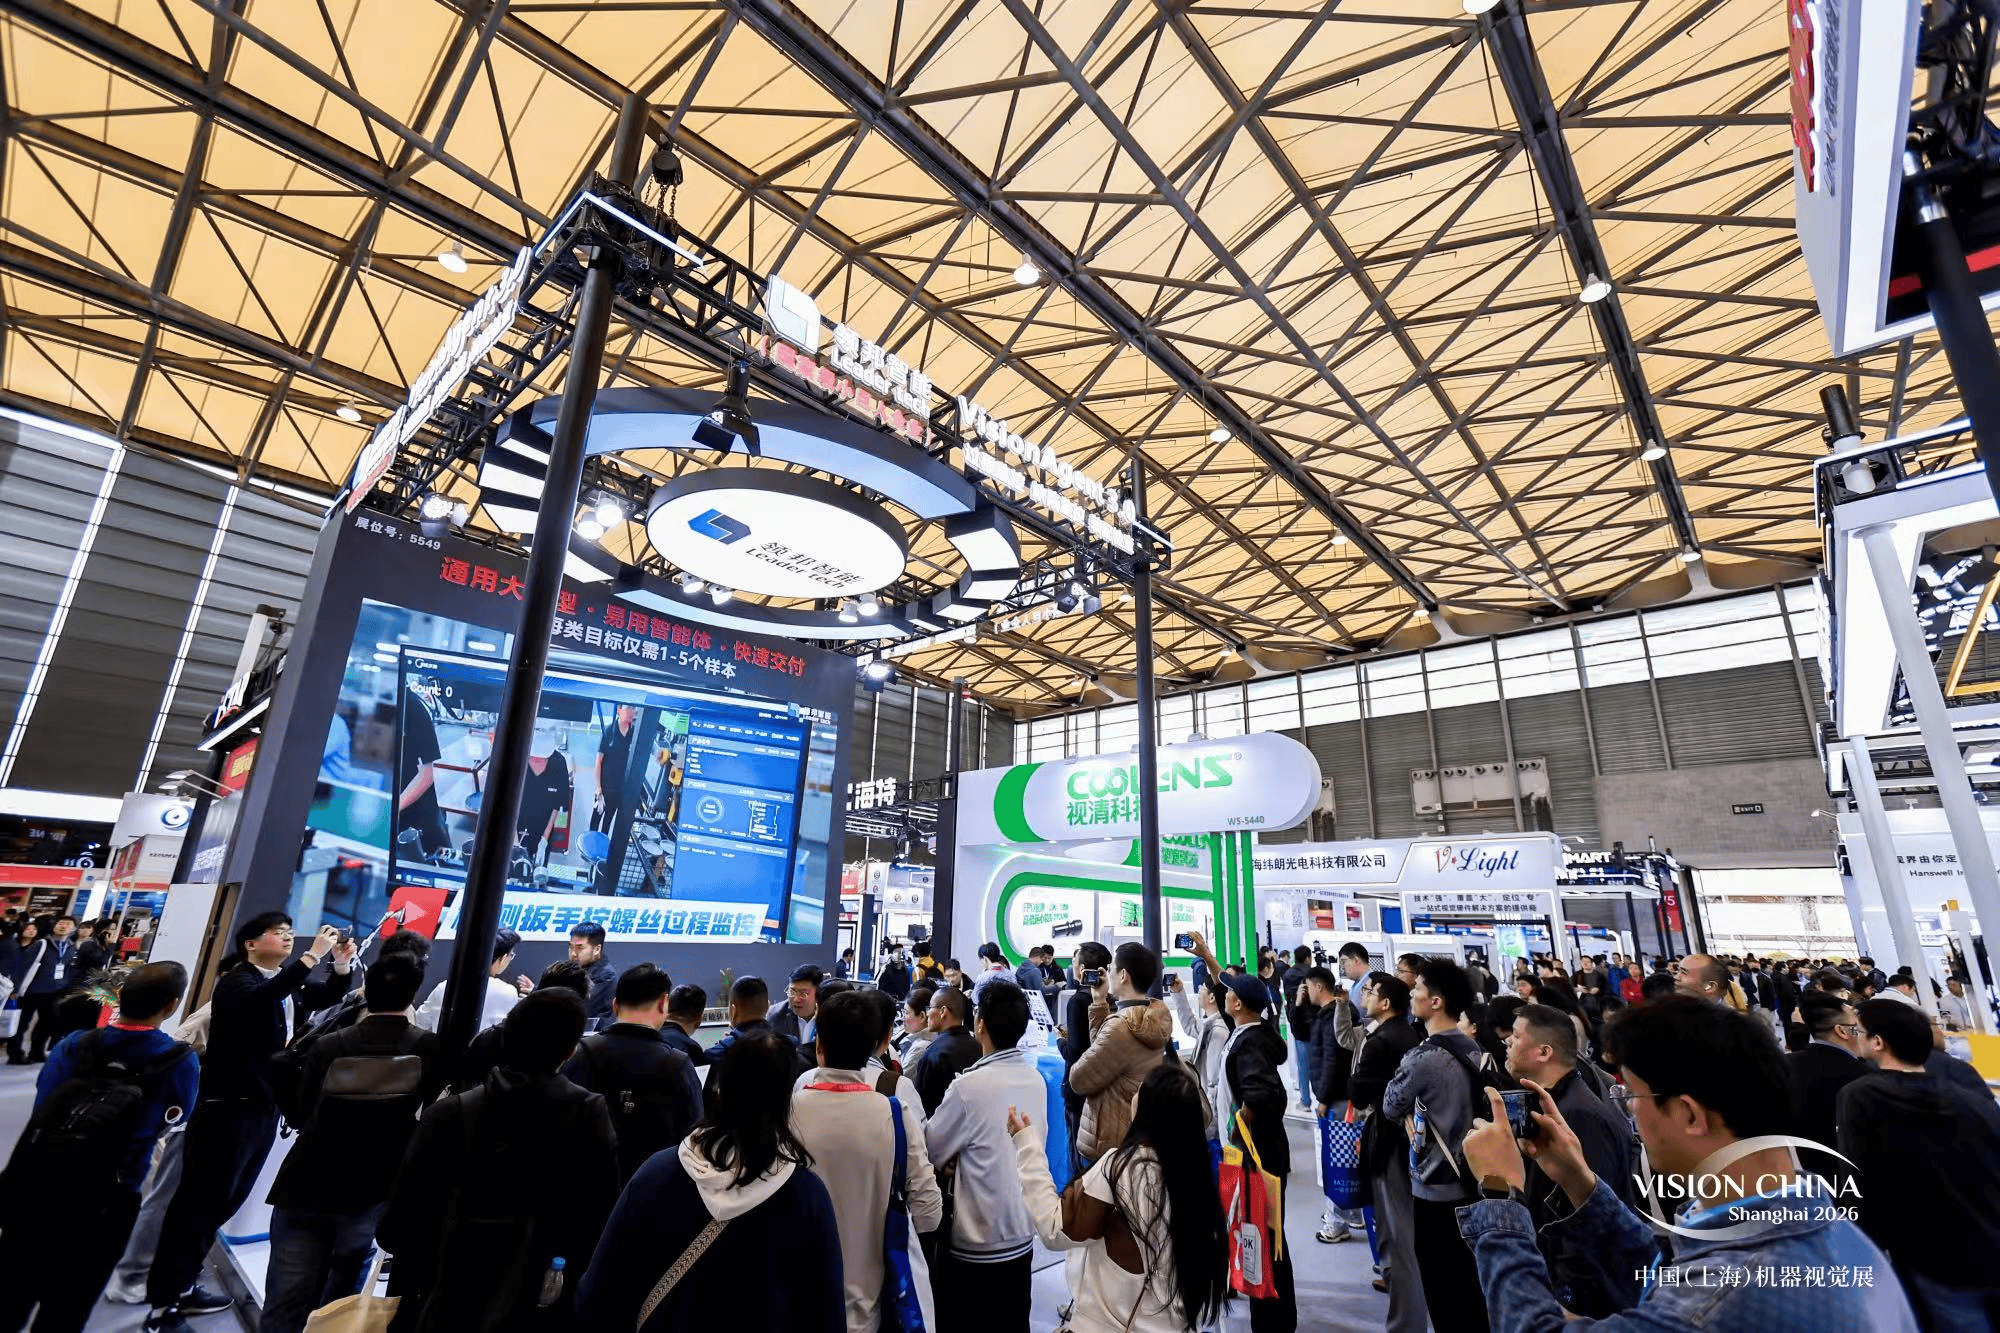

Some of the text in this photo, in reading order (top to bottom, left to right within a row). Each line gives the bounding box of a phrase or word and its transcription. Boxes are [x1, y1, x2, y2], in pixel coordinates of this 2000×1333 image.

[830, 346, 931, 420] Leader tech
[745, 547, 846, 589] Leader tech
[760, 541, 865, 585] 领邦智能
[409, 681, 453, 697] Count: 0
[846, 776, 897, 811] 海特
[1227, 816, 1265, 826] W5-5440
[1909, 869, 1953, 877] Hanswell
